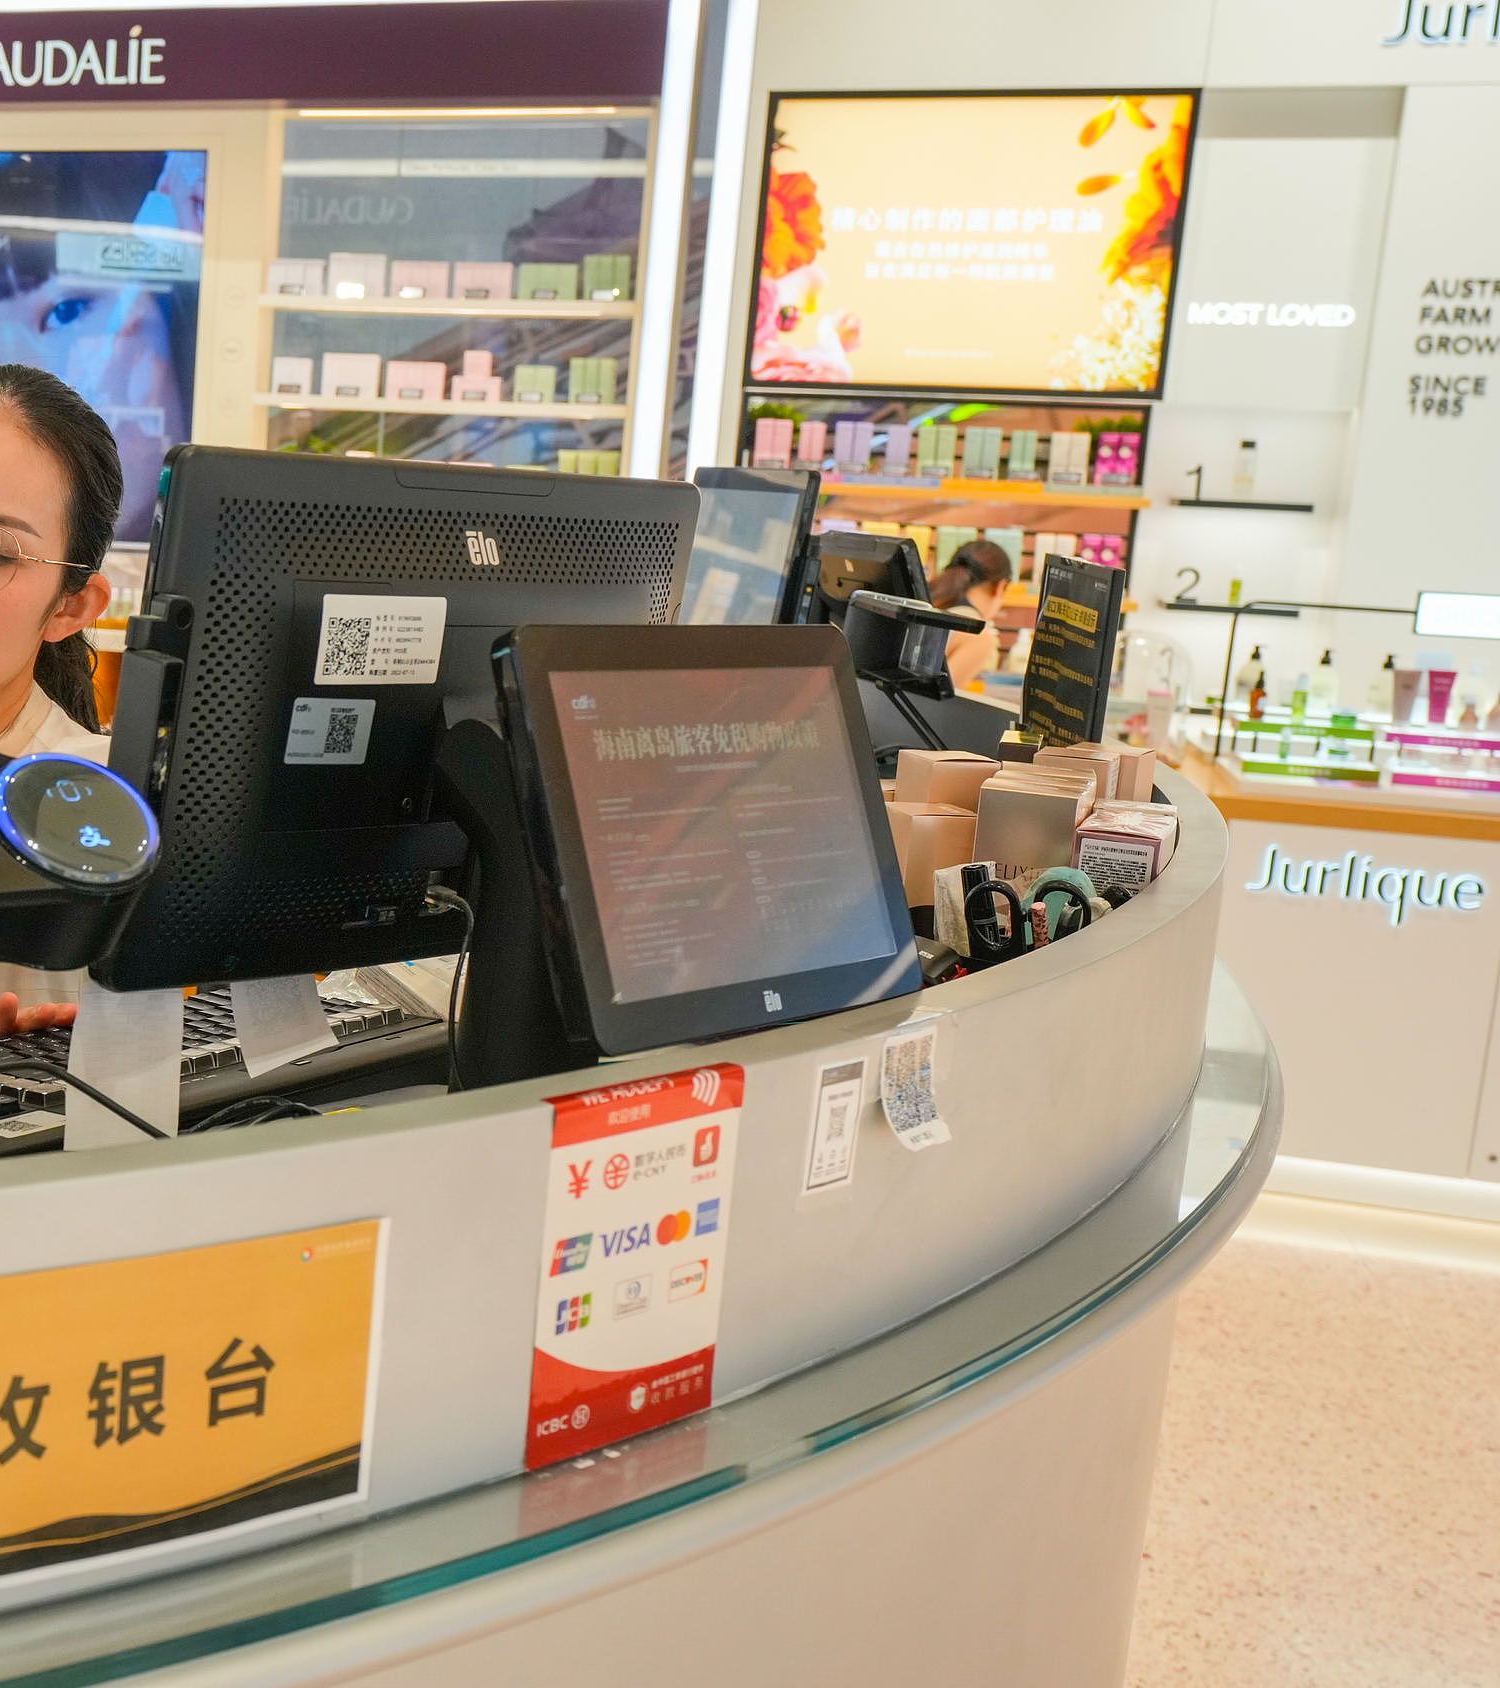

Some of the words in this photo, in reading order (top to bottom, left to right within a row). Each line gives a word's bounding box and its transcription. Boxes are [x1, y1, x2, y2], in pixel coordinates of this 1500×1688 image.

[1187, 302, 1265, 326] MOST
[1266, 304, 1356, 328] LOVED
[1420, 307, 1491, 326] FARM
[1409, 376, 1488, 396] SINCE
[1408, 397, 1463, 417] 1985
[1186, 465, 1202, 501] 1
[1176, 568, 1200, 605] 2
[1244, 844, 1485, 927] Jurlique
[599, 1222, 651, 1258] VISA
[536, 1415, 569, 1438] ICBC
